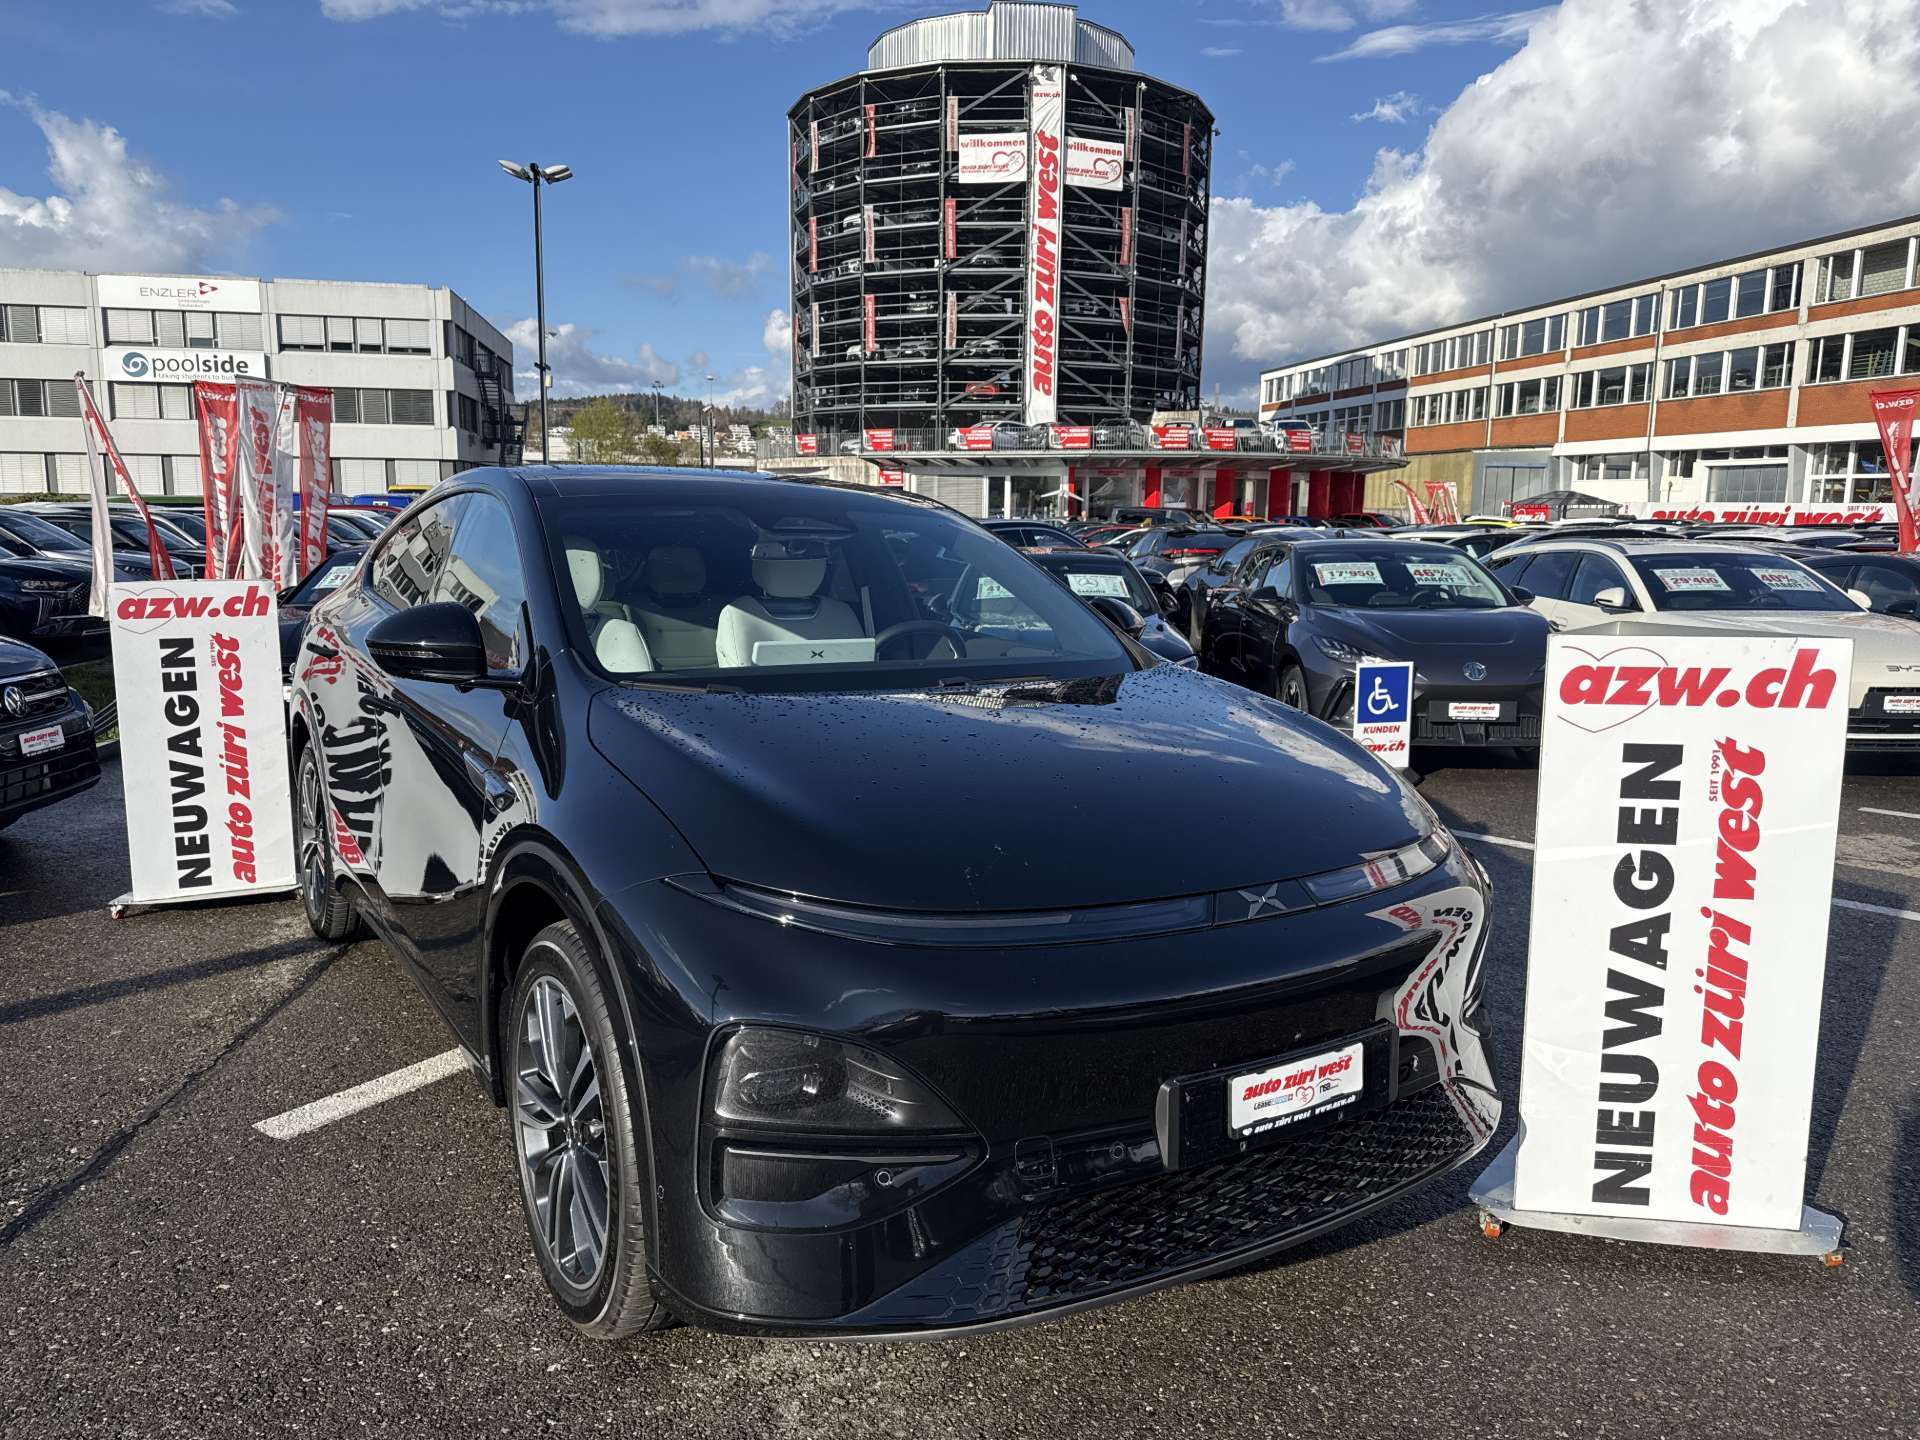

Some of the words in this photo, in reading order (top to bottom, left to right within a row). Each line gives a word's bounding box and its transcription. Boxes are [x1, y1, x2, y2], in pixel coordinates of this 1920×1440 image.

[961, 140, 1025, 148] willkommen
[1035, 130, 1058, 219] west
[1066, 143, 1122, 156] willkommen
[140, 287, 197, 298] ENZLER
[1032, 224, 1057, 308] züri
[152, 354, 248, 378] poolside
[1031, 310, 1053, 396] auto
[117, 585, 270, 620] azw.ch
[210, 632, 245, 718] west
[1559, 648, 1837, 709] azw.ch
[159, 637, 212, 889] NEUWAGEN
[216, 721, 251, 800] züri
[1363, 725, 1400, 734] KUNDEN
[1711, 749, 1721, 774] 1991
[1709, 776, 1719, 803] SEIT
[1712, 736, 1767, 901] west
[225, 802, 257, 884] auto
[1592, 743, 1684, 1206] NEUWAGEN
[1693, 905, 1755, 1062] züri
[1243, 1078, 1282, 1101] auto
[1282, 1064, 1318, 1090] züri
[1318, 1055, 1352, 1079] west
[1254, 1122, 1274, 1134] auto
[1274, 1115, 1292, 1128] züri
[1293, 1110, 1311, 1122] west
[1315, 1094, 1356, 1115] www.azw.ch
[1686, 1060, 1741, 1217] auto
